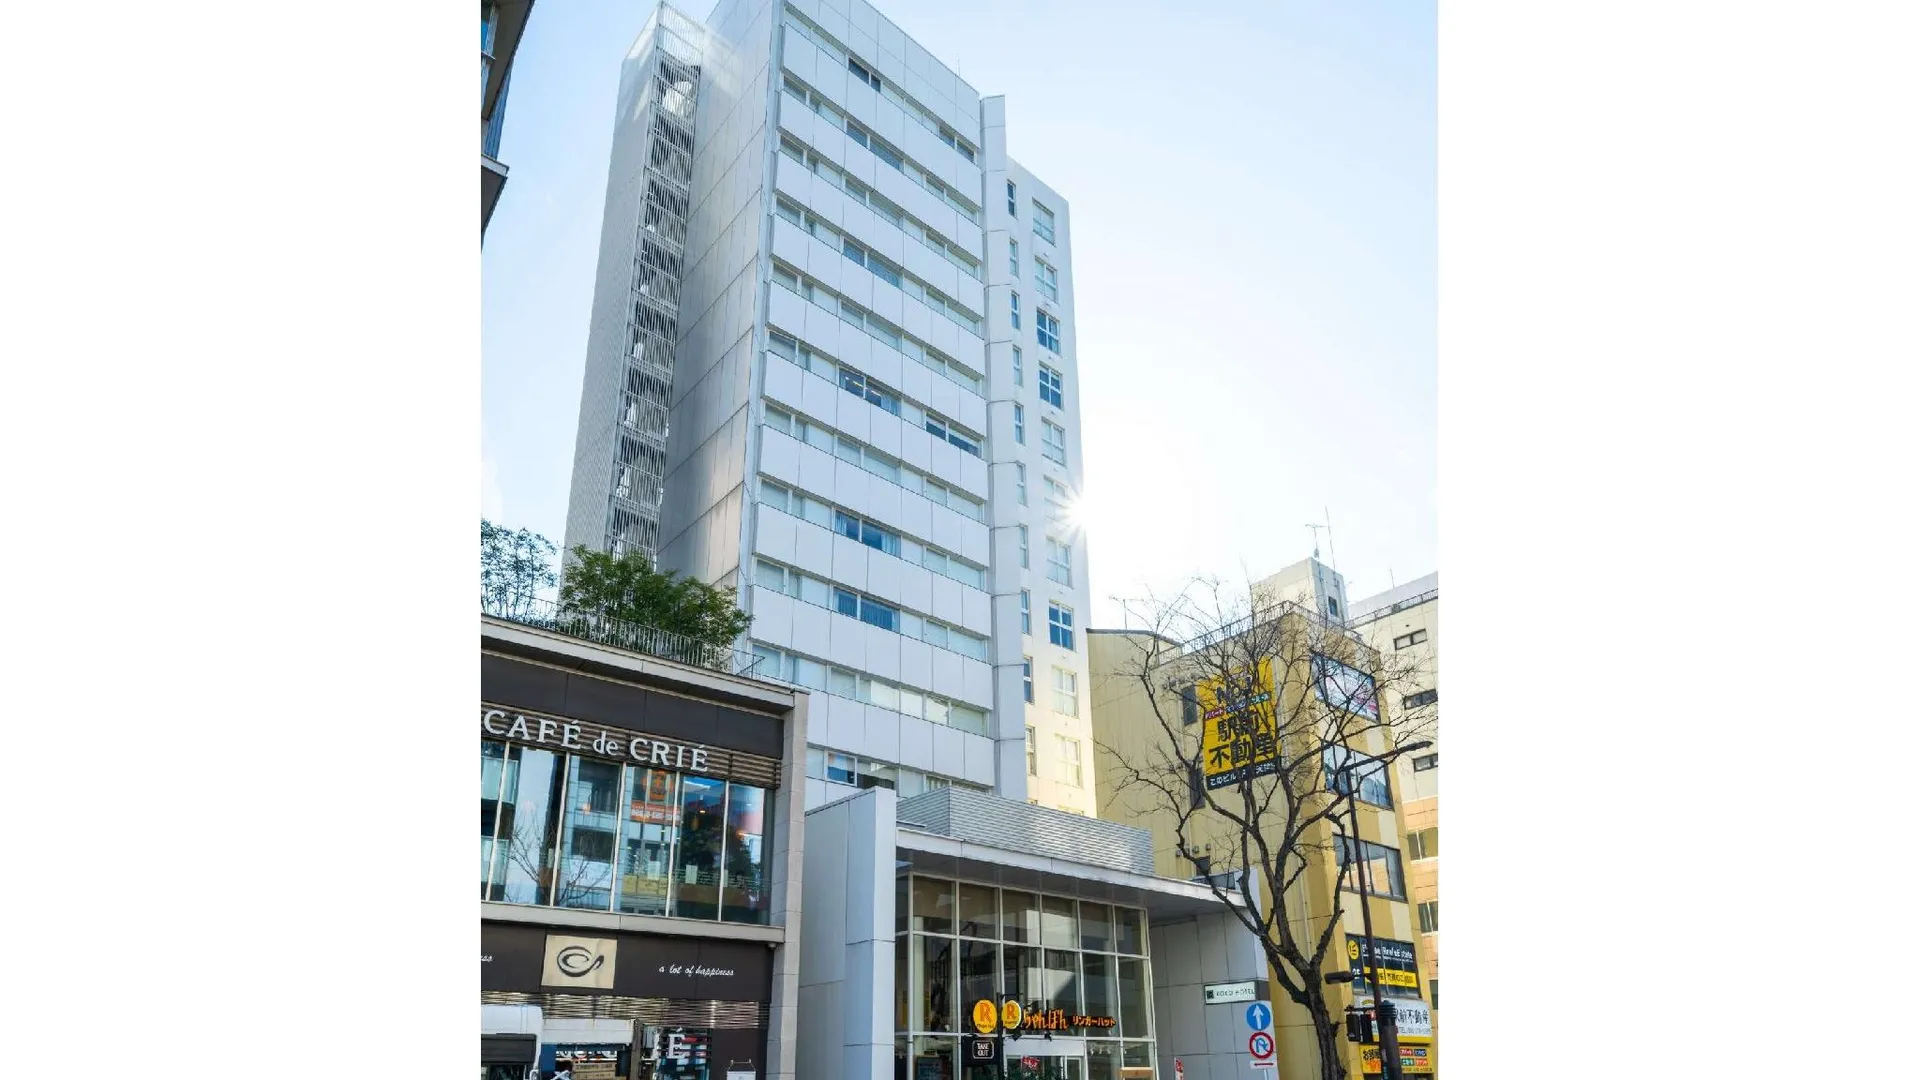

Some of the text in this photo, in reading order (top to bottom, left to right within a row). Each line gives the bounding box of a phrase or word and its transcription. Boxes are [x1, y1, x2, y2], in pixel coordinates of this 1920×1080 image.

[484, 710, 709, 772] CAFÉ de CRIÉ
[669, 964, 682, 974] lot
[685, 965, 695, 977] of
[695, 965, 734, 977] happiness
[977, 1049, 989, 1057] OUT
